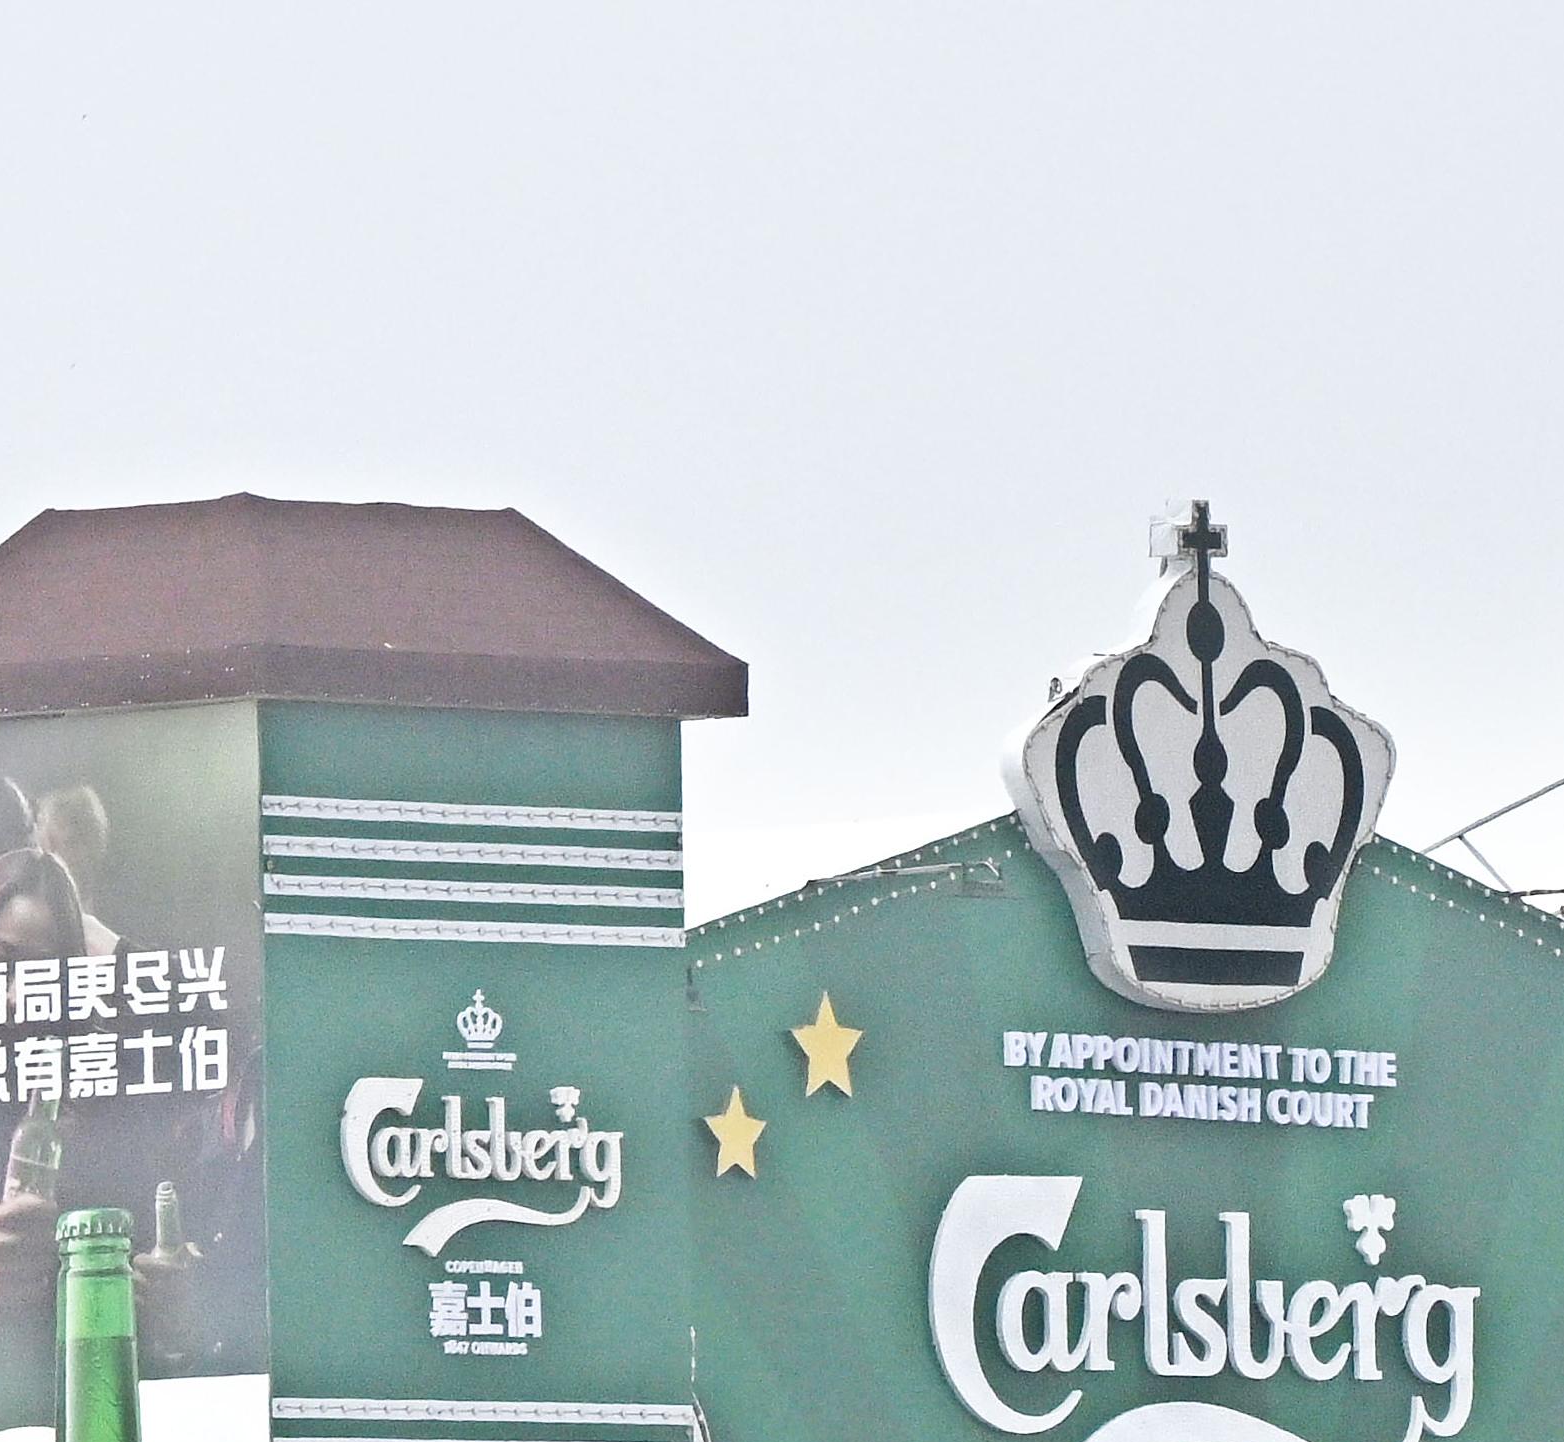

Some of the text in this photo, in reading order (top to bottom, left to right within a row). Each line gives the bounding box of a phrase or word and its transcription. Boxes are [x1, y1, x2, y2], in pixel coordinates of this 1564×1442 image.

[1003, 1031, 1398, 1087] BY APPOINTMENT TO THE
[1030, 1075, 1374, 1129] ROYAL DANISH COURT
[340, 1077, 624, 1256] Carlsberg
[428, 1280, 543, 1338] 嘉士伯
